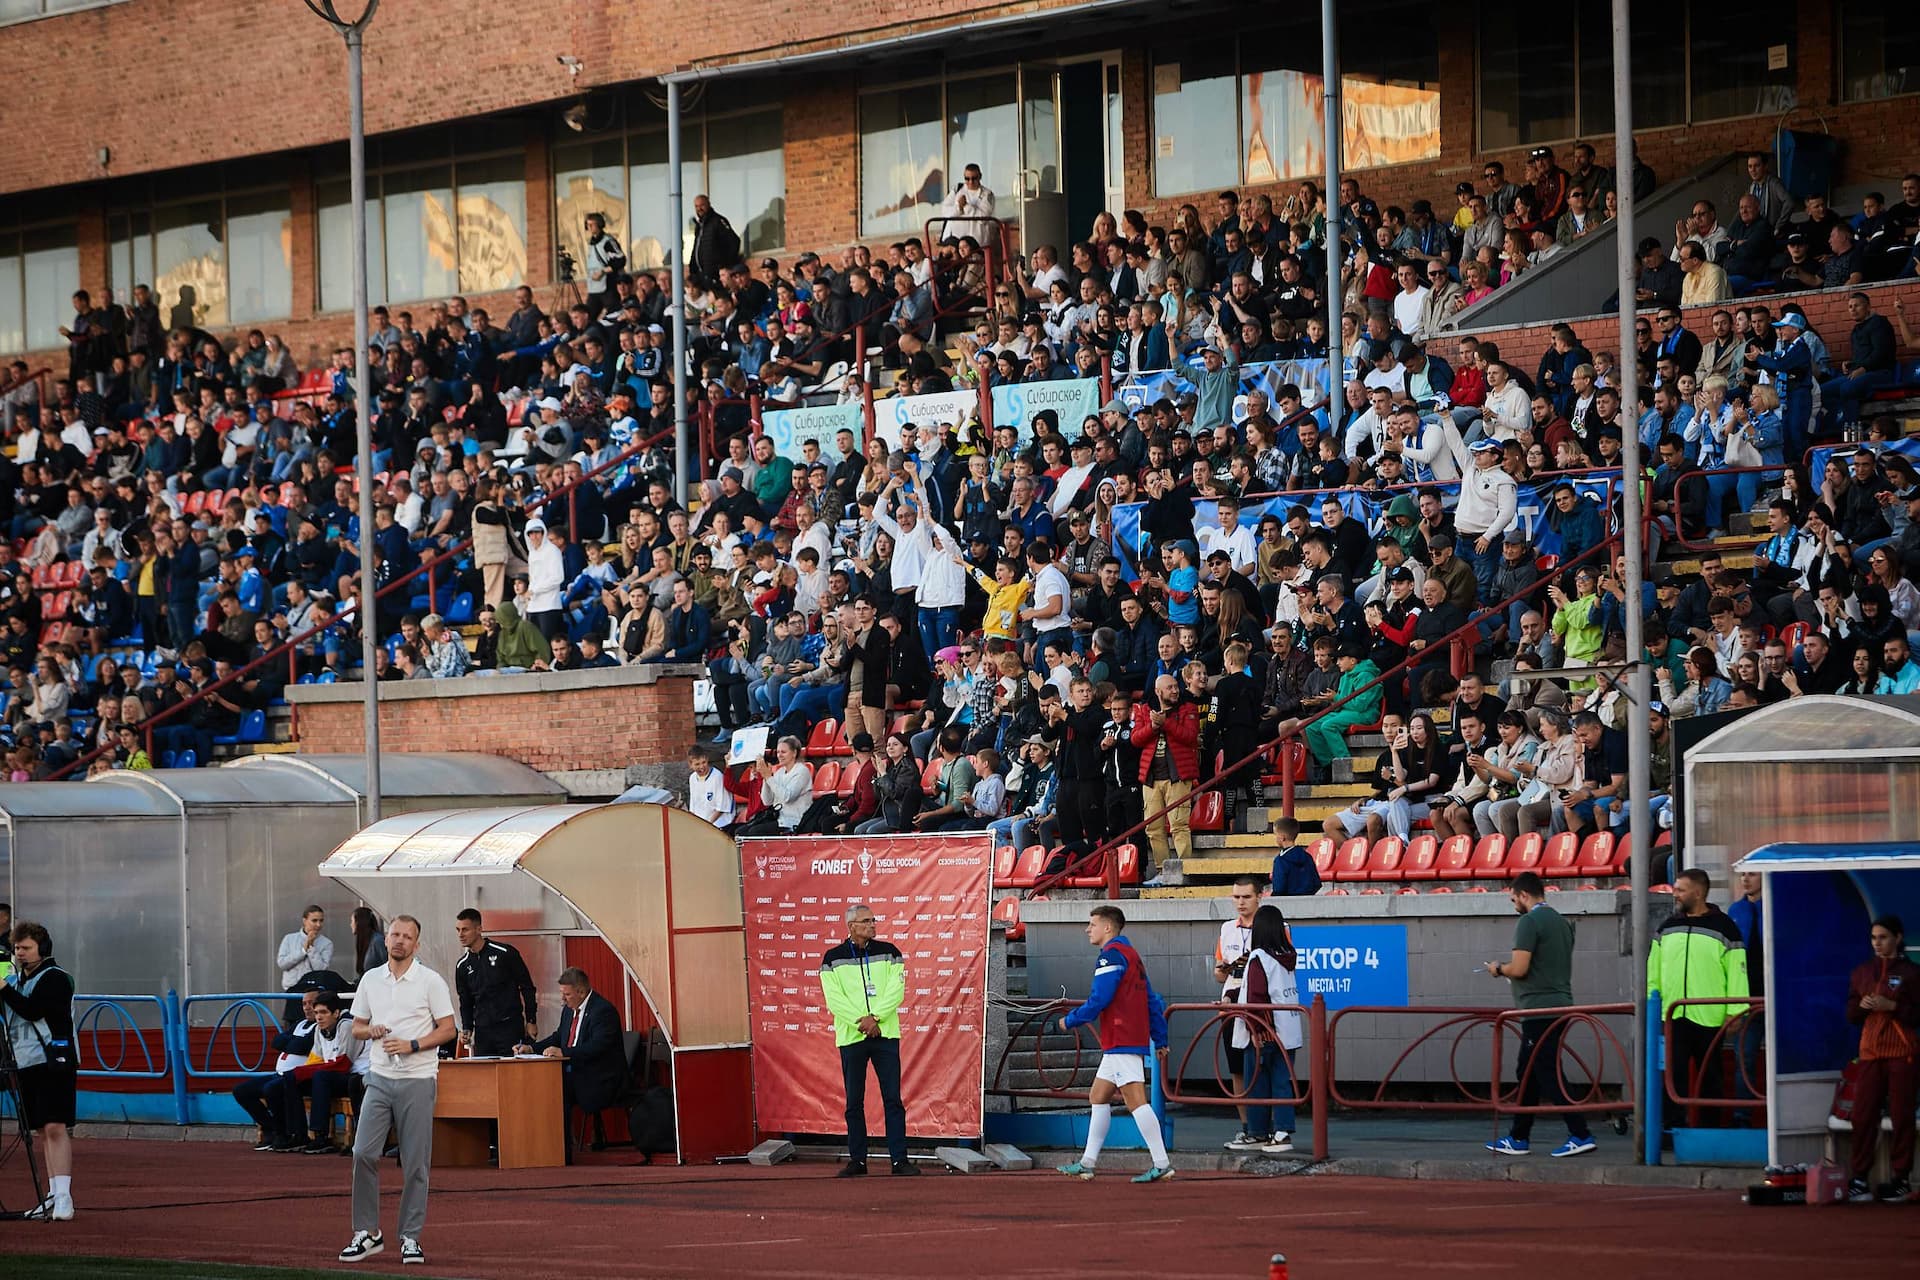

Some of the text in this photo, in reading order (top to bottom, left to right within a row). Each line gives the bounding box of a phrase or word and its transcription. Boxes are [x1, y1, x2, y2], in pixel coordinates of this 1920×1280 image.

[1027, 387, 1081, 405] Сибирское
[911, 403, 954, 416] Сибирское
[794, 412, 846, 430] Сибирское
[811, 859, 854, 875] FONBET
[876, 858, 921, 868] КУБОК РОССИИ
[1296, 947, 1379, 970] ЕКТОР 4
[1308, 978, 1351, 993] МЕСТА 1-17
